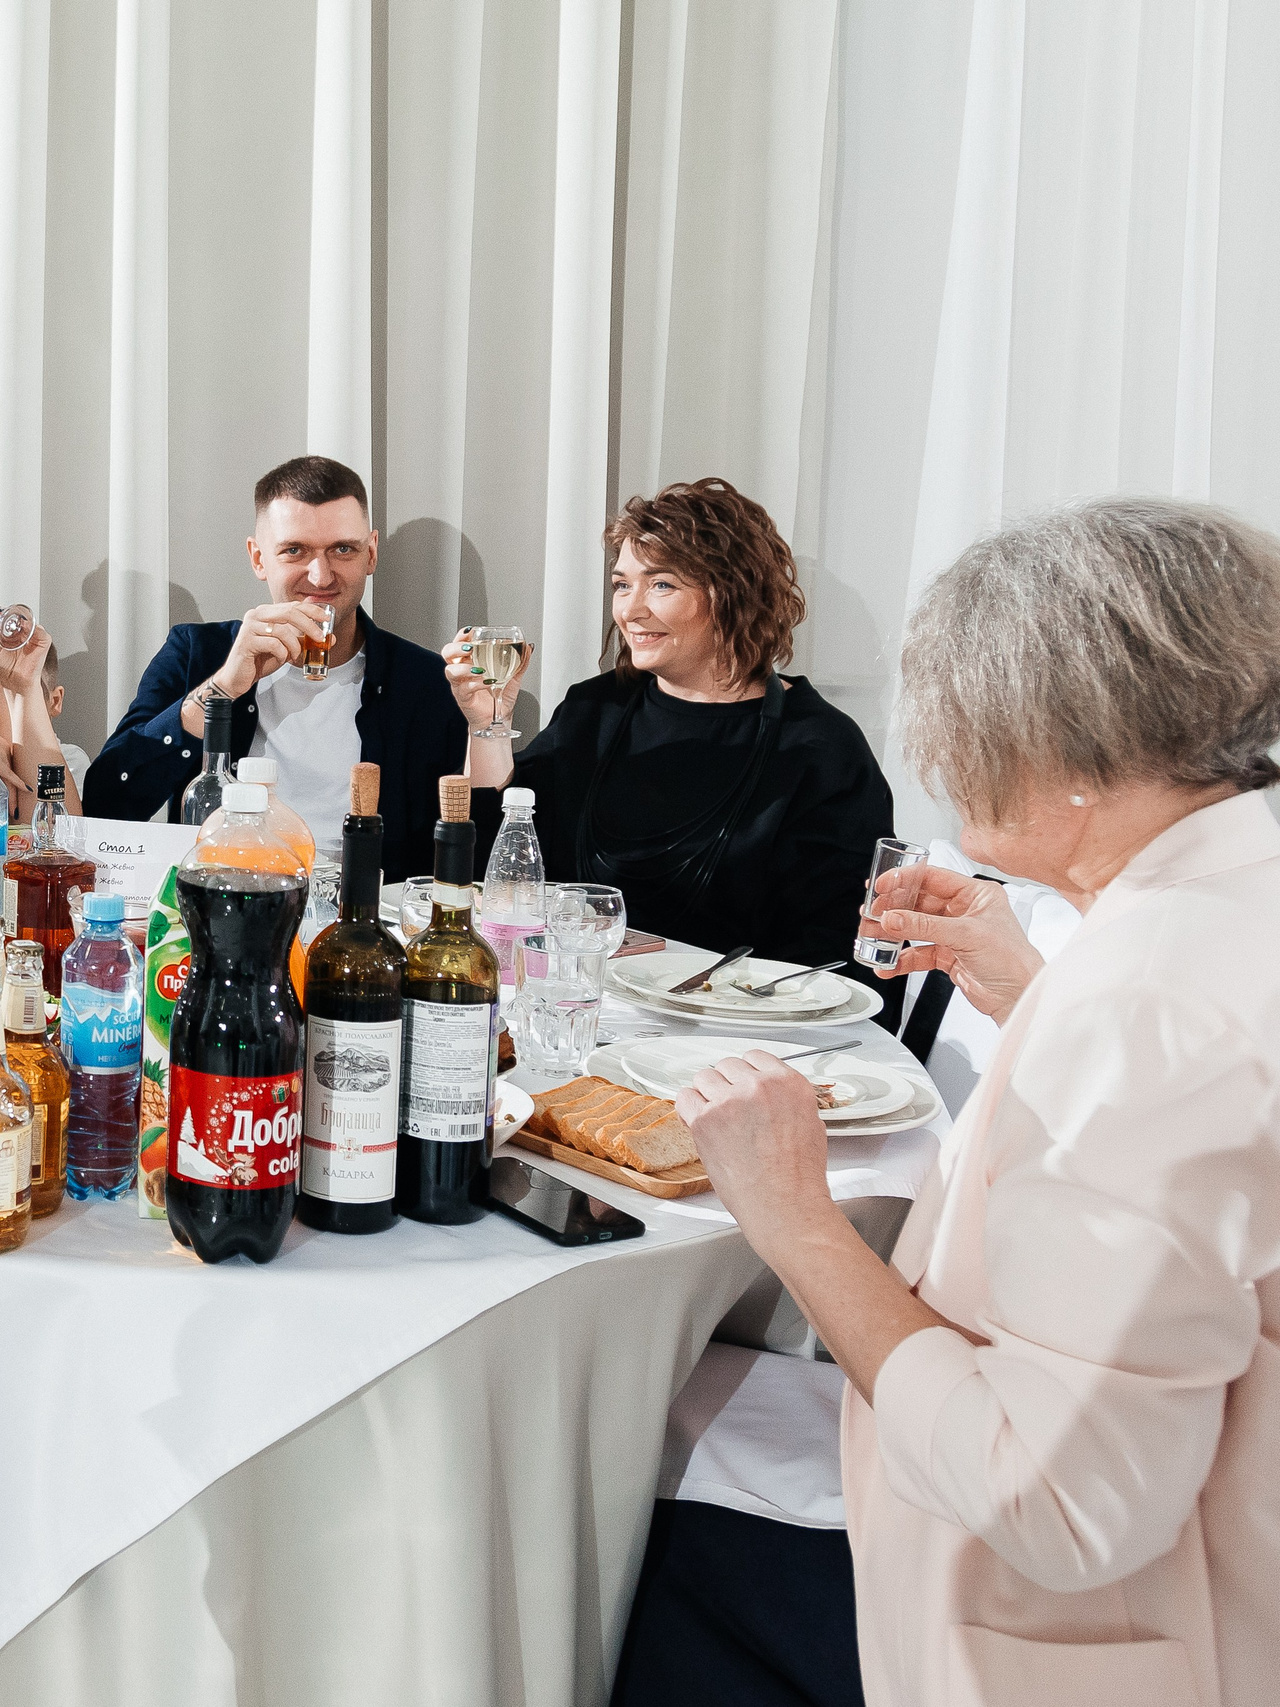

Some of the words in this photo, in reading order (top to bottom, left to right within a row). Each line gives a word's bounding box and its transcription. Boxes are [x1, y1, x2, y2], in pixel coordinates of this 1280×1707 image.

[98, 841, 132, 853] Стол
[138, 844, 145, 854] 1
[268, 1150, 299, 1176] cola
[323, 1167, 375, 1179] КАДАРКА
